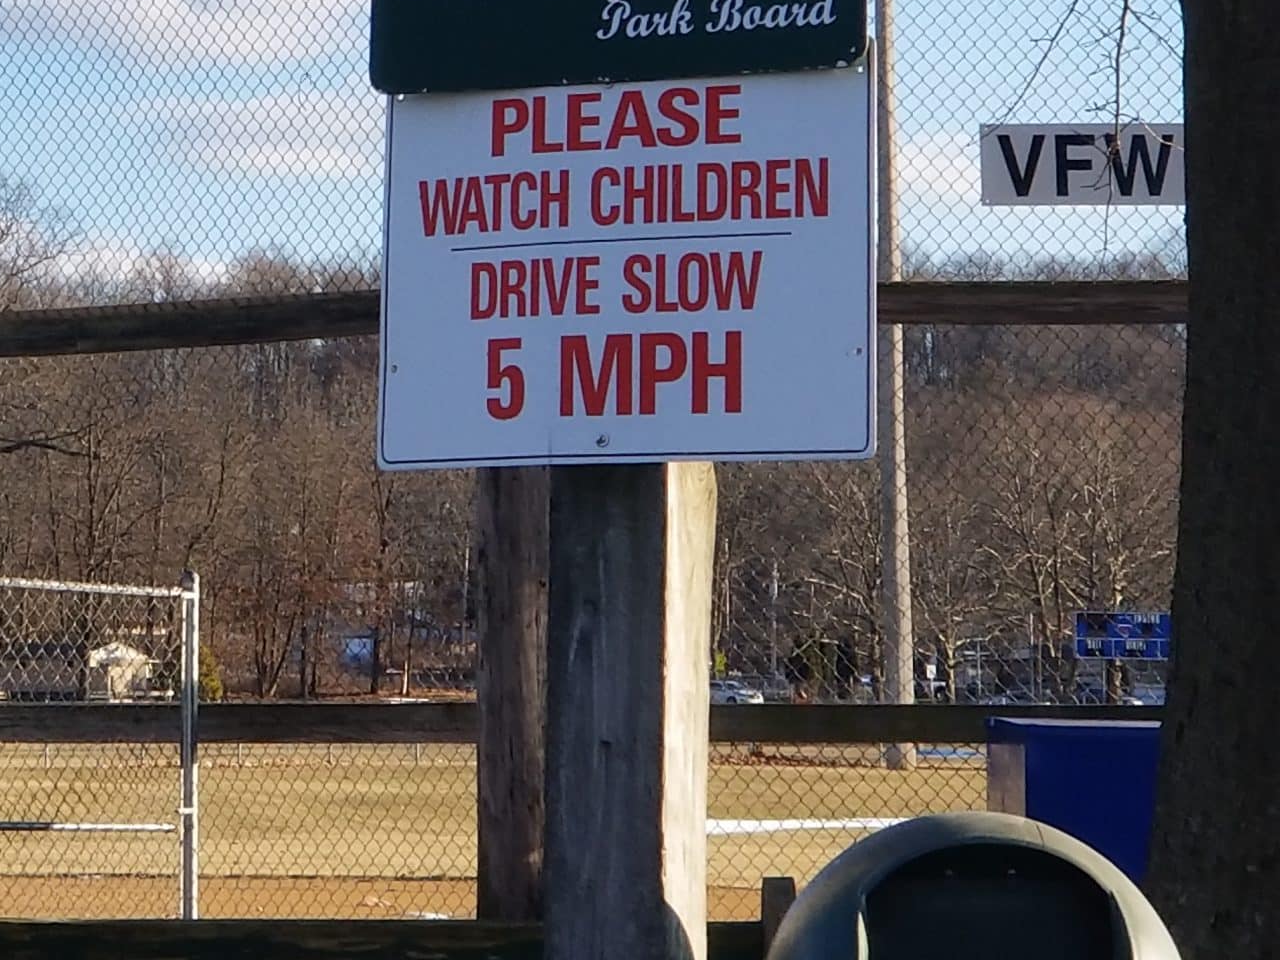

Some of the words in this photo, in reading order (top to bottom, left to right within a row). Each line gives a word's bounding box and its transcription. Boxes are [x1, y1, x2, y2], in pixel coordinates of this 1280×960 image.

[491, 85, 742, 157] PLEASE
[419, 169, 570, 236] WATCH
[590, 157, 829, 226] CHILDREN
[996, 134, 1174, 197] VFW
[470, 256, 601, 320] DRIVE
[621, 250, 763, 313] SLOW
[486, 337, 525, 421] 5
[559, 330, 742, 417] MPH
